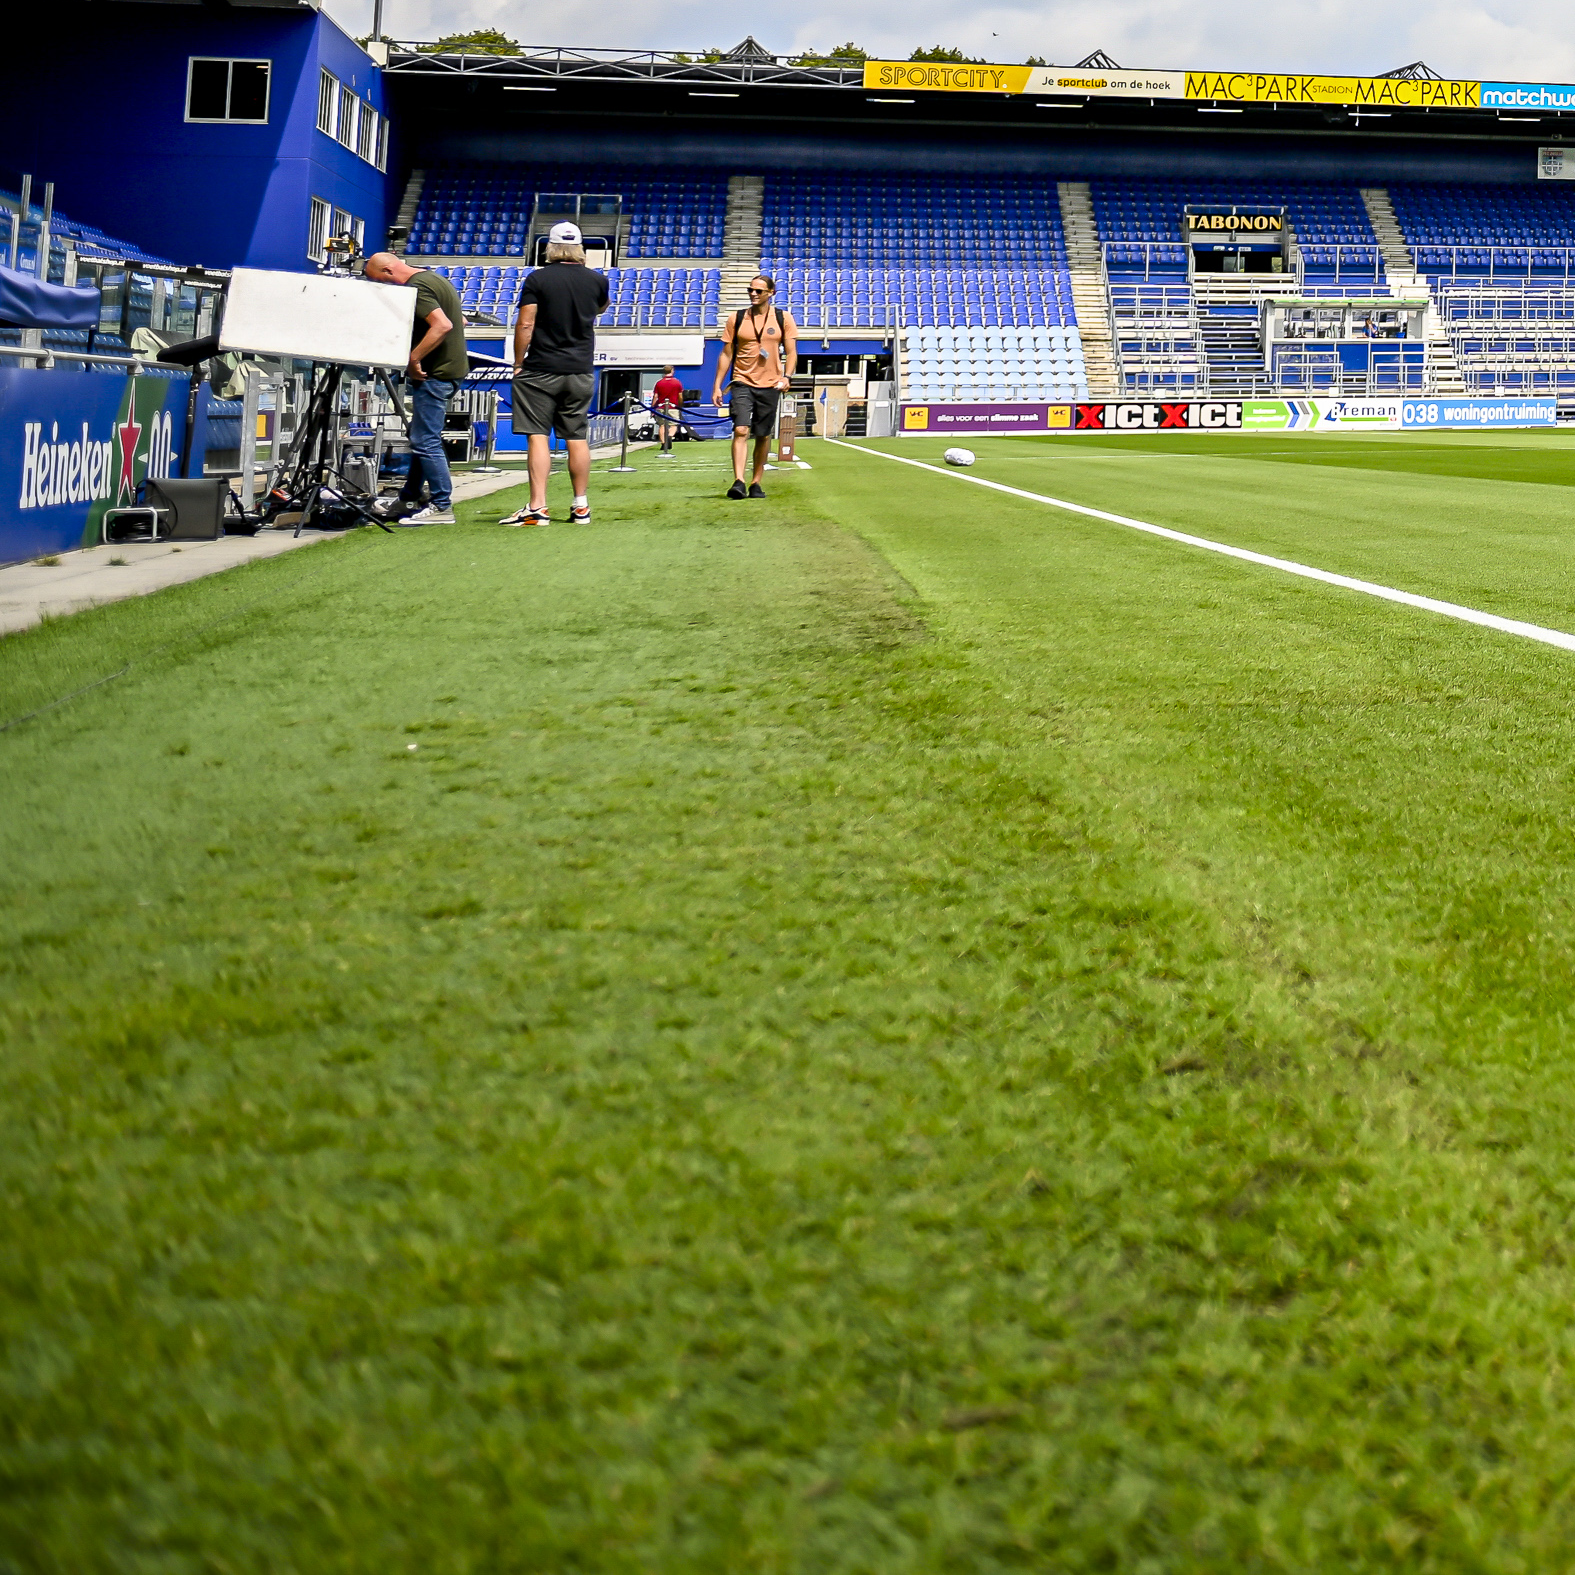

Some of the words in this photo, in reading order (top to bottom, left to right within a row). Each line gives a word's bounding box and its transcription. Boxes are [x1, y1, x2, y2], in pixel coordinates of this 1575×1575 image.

[1042, 75, 1054, 86] Je
[1057, 77, 1108, 89] sportclub
[1110, 80, 1127, 89] om
[1130, 78, 1143, 89] de
[1145, 79, 1171, 90] hoek
[1312, 84, 1353, 95] STADION
[1186, 215, 1282, 230] TABONON
[142, 262, 188, 274] voetbalshop.nl
[990, 413, 1018, 422] slimme
[1020, 413, 1039, 422] zaak
[1325, 402, 1397, 422] Breman
[1402, 403, 1439, 424] 038
[1443, 402, 1556, 424] woningontruiming
[20, 421, 114, 509] Heineken
